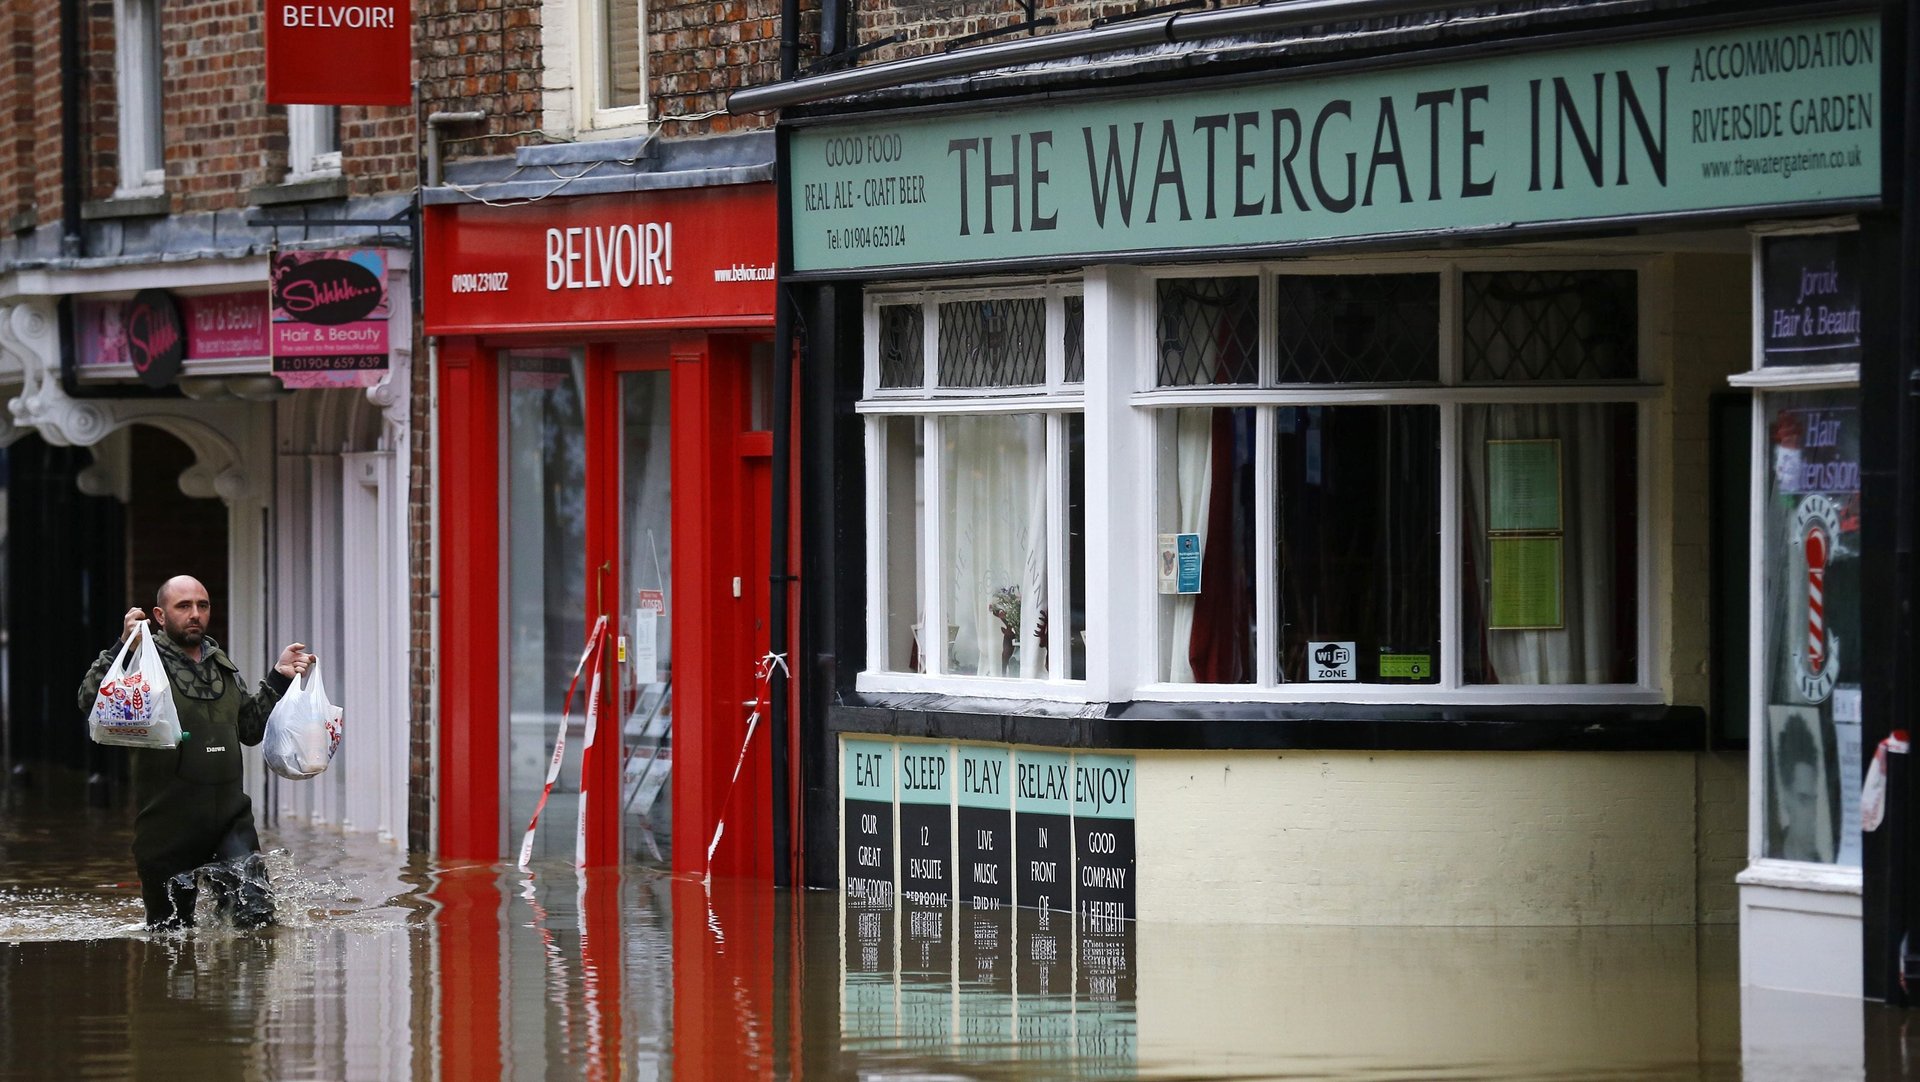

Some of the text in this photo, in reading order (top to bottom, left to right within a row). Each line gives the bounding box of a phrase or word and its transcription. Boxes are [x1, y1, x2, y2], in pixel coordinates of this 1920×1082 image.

[283, 5, 394, 29] BELVOIR!
[1690, 27, 1874, 83] ACCOMMODATION
[1692, 93, 1872, 144] RIVERSIDE GARDEN
[825, 133, 902, 167] GOOD FOOD
[947, 65, 1671, 236] THE WATERGATE INN
[1701, 145, 1862, 179] www.thewatergateinn.co.uk
[805, 183, 830, 211] REAL
[834, 180, 854, 210] ALE
[864, 177, 896, 207] CRAFT
[900, 175, 926, 205] BEER
[827, 224, 905, 250] Tel: 01904 625124
[546, 221, 673, 291] BELVOIR!
[452, 272, 508, 293] 01904 231022
[1772, 308, 1800, 338] Hair
[1802, 306, 1814, 336] &
[280, 327, 381, 344] Hair & Beauty
[293, 358, 330, 370] 01904
[333, 357, 354, 369] 659
[358, 356, 380, 369] 639
[1805, 412, 1841, 448] Hair
[1318, 669, 1347, 678] ZONE
[1412, 664, 1419, 673] 4
[856, 752, 882, 788] EAT
[904, 755, 945, 790] SLEEP
[964, 758, 1001, 795] PLAY
[1018, 763, 1069, 801] RELAX
[1076, 767, 1130, 814] ENJOY
[861, 813, 878, 834] OUR
[920, 826, 929, 846] 12
[977, 829, 993, 850] LIVE
[1038, 827, 1048, 848] IN
[1088, 832, 1116, 854] GOOD
[858, 845, 881, 867] GREAT
[910, 858, 942, 880] EN-SUITE
[973, 862, 998, 885] MUSIC
[1031, 861, 1056, 883] FRONT
[1082, 865, 1126, 889] COMPANY
